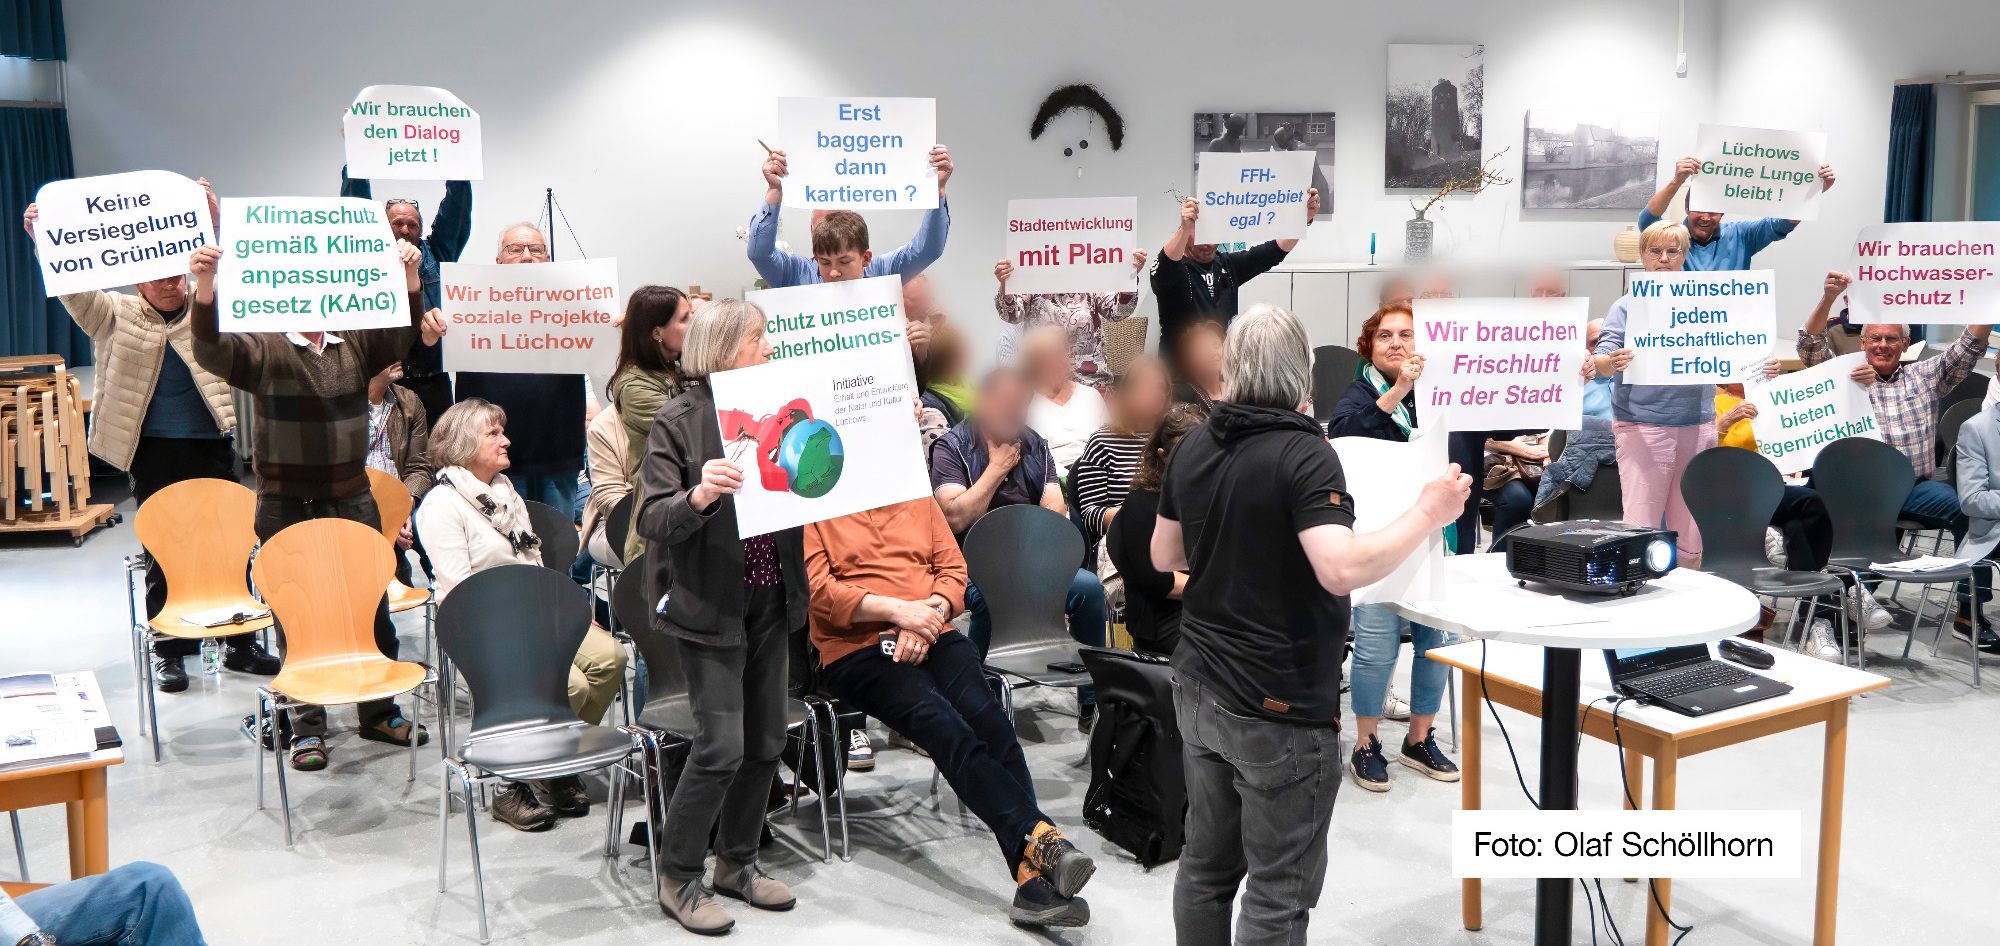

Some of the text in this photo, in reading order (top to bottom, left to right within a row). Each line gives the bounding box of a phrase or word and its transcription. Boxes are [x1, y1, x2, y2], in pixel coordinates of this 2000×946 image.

[351, 101, 470, 118] Wir brauchen
[839, 104, 881, 120] Erst
[364, 124, 460, 143] den Dialog
[818, 131, 902, 152] baggern
[388, 148, 437, 165] jetzt !
[1722, 142, 1800, 160] Lüchows
[835, 159, 886, 175] dann
[1241, 168, 1276, 183] FFH-
[1702, 161, 1814, 185] Grüne Lunge
[806, 185, 917, 202] kartieren ?
[1206, 190, 1303, 207] Schutzgebiet
[1725, 184, 1783, 201] bleibt !
[86, 193, 150, 213] Keine
[246, 206, 378, 224] Klimaschutz
[1230, 212, 1275, 229] egal ?
[46, 211, 197, 246] Versiegelung
[1010, 217, 1133, 232] Stadtentwicklung
[50, 232, 205, 274] von Grünland
[236, 235, 390, 259] gemäß Klima-
[1020, 243, 1122, 266] mit Plan
[1858, 240, 1994, 256] Wir brauchen
[242, 268, 387, 288] anpassungs-
[1859, 266, 1993, 281] Hochwasser-
[445, 285, 613, 302] Wir befürworten
[1632, 279, 1768, 297] Wir wünschen
[232, 292, 396, 319] gesetz (KAnG)
[1883, 290, 1964, 305] schutz !
[453, 310, 610, 327] soziale Projekte
[767, 304, 897, 333] chutz unserer
[1670, 307, 1727, 328] jedem
[1426, 321, 1577, 341] Wir brauchen
[1634, 331, 1767, 347] wirtschaftlichen
[472, 333, 593, 350] in Lüchow
[768, 330, 900, 360] aherholungs-
[1453, 353, 1560, 374] Frischluft
[1671, 357, 1731, 377] Erfolg
[833, 375, 874, 391] Initiative
[1770, 378, 1835, 406] Wiesen
[857, 390, 869, 398] und
[1432, 384, 1562, 406] in der Stadt
[849, 403, 867, 412] Natur
[869, 399, 881, 408] und
[1780, 403, 1836, 428] bieten
[1756, 416, 1875, 457] Regenrückhalt
